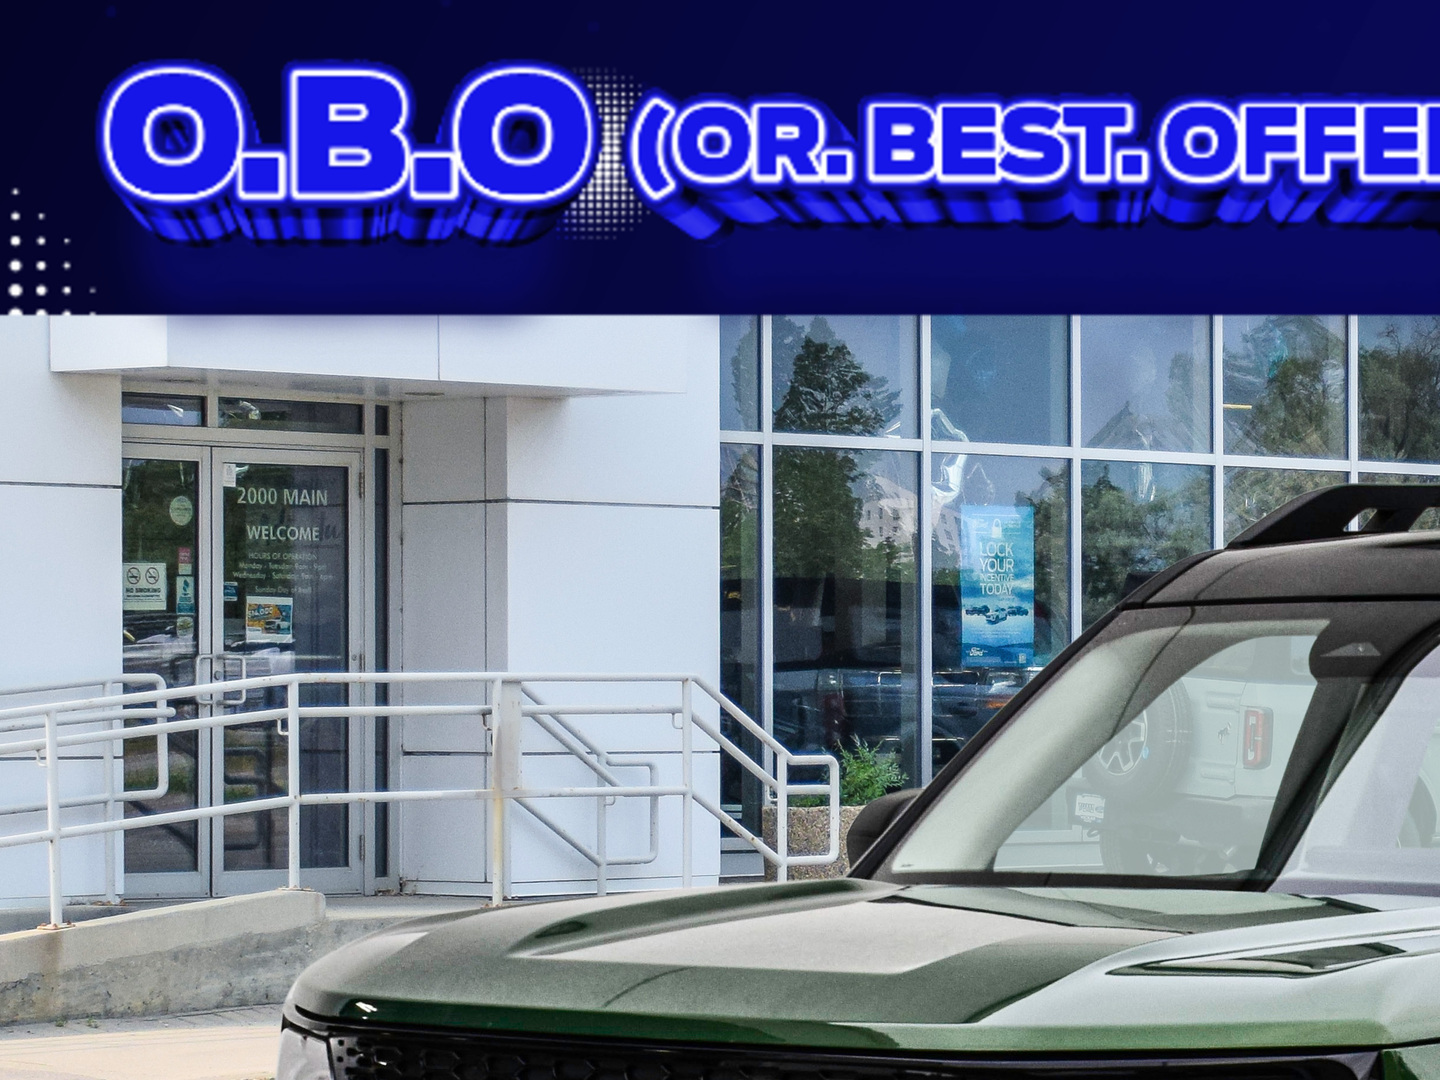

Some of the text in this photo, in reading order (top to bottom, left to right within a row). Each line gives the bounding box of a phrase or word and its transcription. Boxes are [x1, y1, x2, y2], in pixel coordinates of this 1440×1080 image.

[237, 487, 329, 507] 2000 MAIN
[246, 525, 320, 541] WELCOME
[248, 552, 271, 560] HOURS
[980, 542, 1014, 556] LOCK
[980, 558, 1015, 572] YOUR
[980, 583, 1013, 595] TODAY
